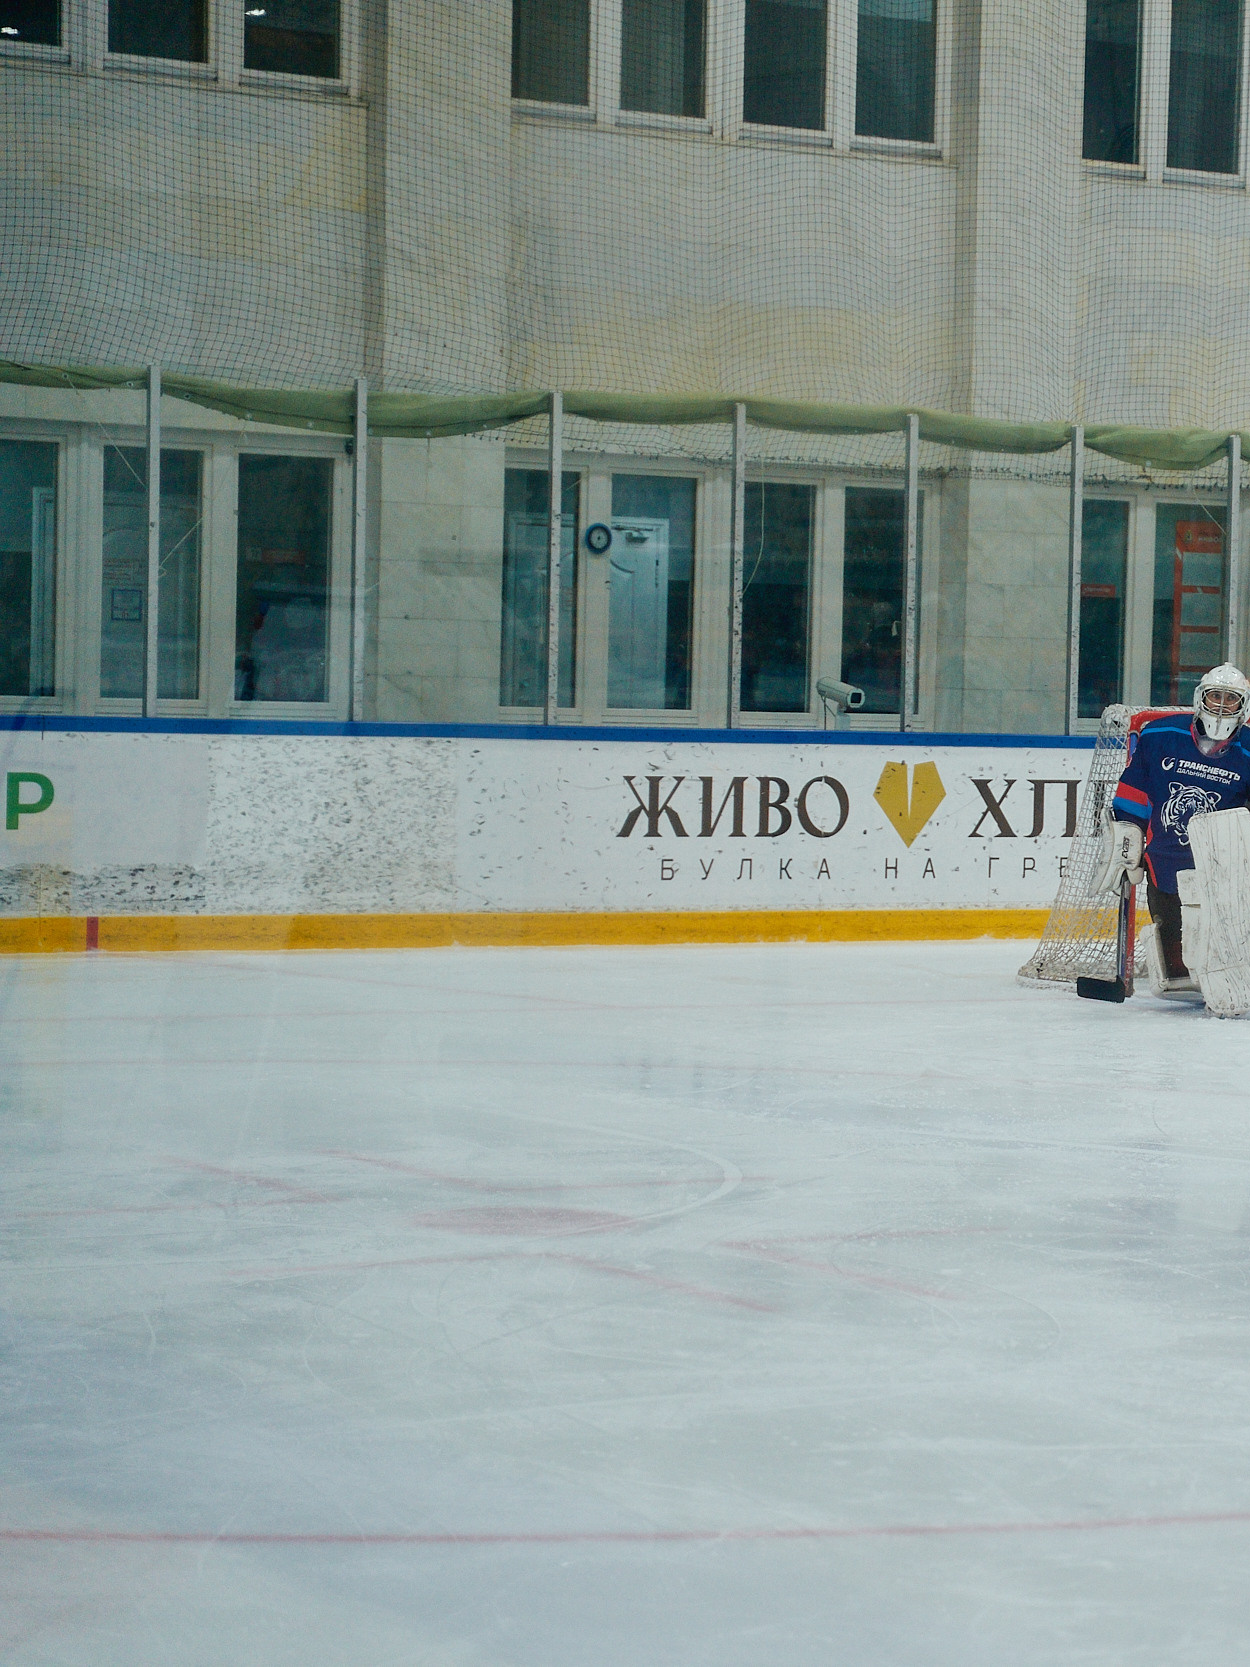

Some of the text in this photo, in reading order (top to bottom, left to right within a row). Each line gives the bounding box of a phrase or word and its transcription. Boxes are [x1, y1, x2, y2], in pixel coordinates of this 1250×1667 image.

[1178, 759, 1241, 781] ТРАНСНЕФТЬ
[616, 775, 850, 839] ЖИВО
[660, 857, 832, 881] БУЛКА
[883, 857, 936, 880] НА
